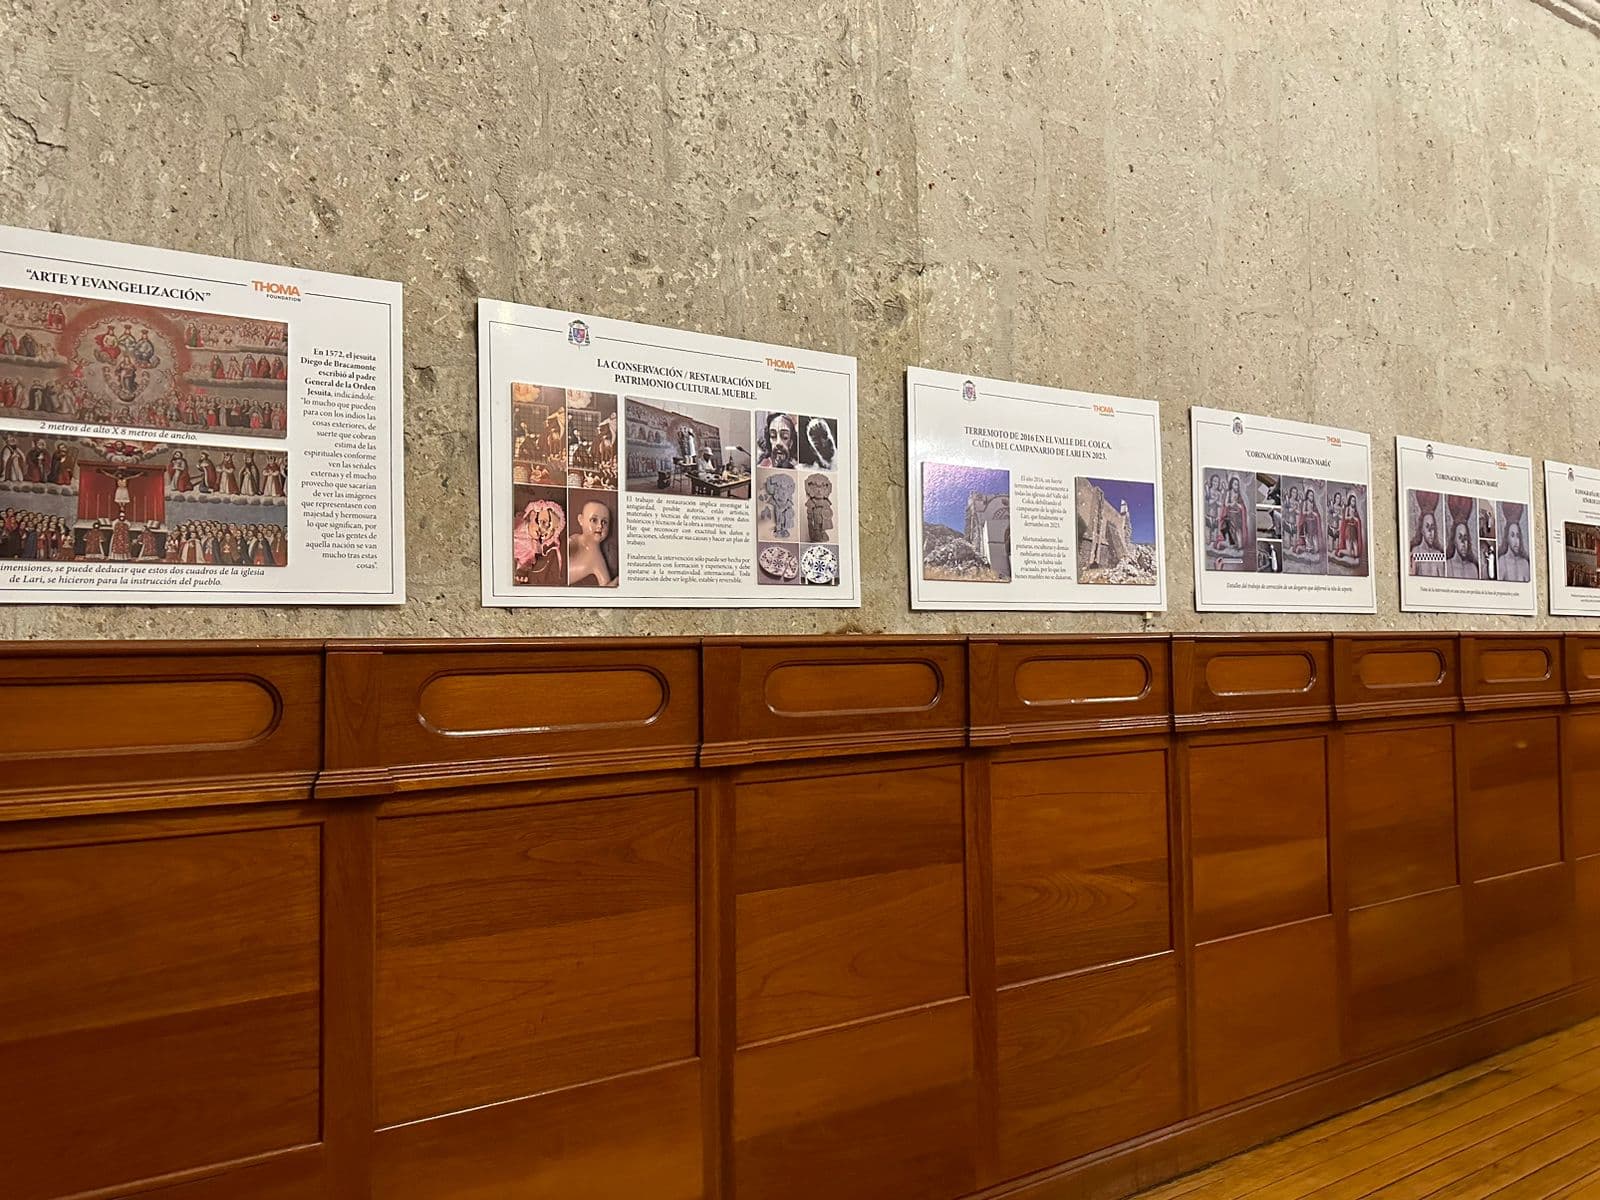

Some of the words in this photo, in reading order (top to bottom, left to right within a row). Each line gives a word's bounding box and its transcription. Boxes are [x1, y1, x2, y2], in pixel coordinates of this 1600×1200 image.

[26, 269, 67, 284] “ARTE
[70, 274, 79, 286] Y
[82, 276, 211, 301] EVANGELIZACIÓN”
[252, 280, 300, 296] THOMA
[266, 294, 301, 302] FOUNDATION
[314, 348, 323, 356] En
[353, 352, 376, 362] jesuita
[300, 357, 322, 368] Diego
[323, 359, 332, 367] de
[333, 360, 376, 371] Bracamonte
[766, 358, 795, 370] THOMA
[318, 370, 346, 378] escribió
[355, 373, 376, 382] padre
[597, 359, 609, 369] LA
[610, 360, 682, 378] CONSERVACIÓN
[689, 371, 753, 388] RESTAURACIÓN
[755, 379, 771, 390] DEL
[305, 378, 333, 387] General
[335, 380, 343, 388] de
[352, 382, 376, 390] Orden
[615, 374, 673, 390] PATRIMONIO
[675, 382, 719, 395] CULTURAL
[721, 387, 757, 400] MUEBLE.
[336, 402, 349, 410] que
[350, 402, 376, 411] pueden
[303, 410, 318, 418] para
[333, 410, 344, 418] los
[344, 411, 365, 419] indios
[40, 422, 46, 430] 2
[47, 424, 78, 432] metros
[79, 425, 91, 433] de
[92, 426, 110, 434] alto
[111, 427, 119, 435] X
[128, 430, 156, 438] metros
[158, 430, 168, 438] de
[170, 432, 197, 440] ancho.
[352, 432, 376, 440] cobran
[964, 426, 1008, 438] TERREMOTO
[1009, 431, 1018, 439] DE
[1020, 432, 1034, 441] 2016
[1035, 434, 1044, 442] EN
[1045, 435, 1053, 443] EL
[1054, 436, 1073, 445] VALLE
[1074, 438, 1086, 447] DEL
[1088, 440, 1112, 449] COLCA.
[334, 441, 356, 449] estima
[972, 439, 994, 449] CAÍDA
[995, 442, 1008, 450] DEL
[1009, 443, 1054, 455] CAMPANARIO
[1055, 448, 1064, 456] DE
[1065, 449, 1080, 458] LARI
[1092, 452, 1107, 460] 2023.
[304, 450, 342, 459] espirituales
[343, 452, 376, 460] conforme
[352, 472, 376, 480] mucho
[301, 480, 333, 488] provecho
[301, 501, 314, 509] que
[315, 502, 362, 510] representasen
[314, 522, 328, 530] que
[364, 524, 376, 532] por
[321, 532, 334, 540] que
[345, 533, 367, 541] gentes
[306, 541, 330, 550] aquella
[0, 564, 53, 574] imensiones,
[66, 565, 93, 575] puede
[94, 565, 128, 573] deducir
[129, 568, 146, 576] que
[169, 566, 183, 574] dos
[185, 567, 217, 575] cuadros
[219, 567, 229, 575] de
[240, 568, 265, 578] iglesia
[22, 576, 45, 585] Lari,
[58, 576, 94, 584] hicieron
[96, 579, 117, 587] para
[130, 577, 176, 585] instrucción
[193, 578, 222, 588] pueblo.
